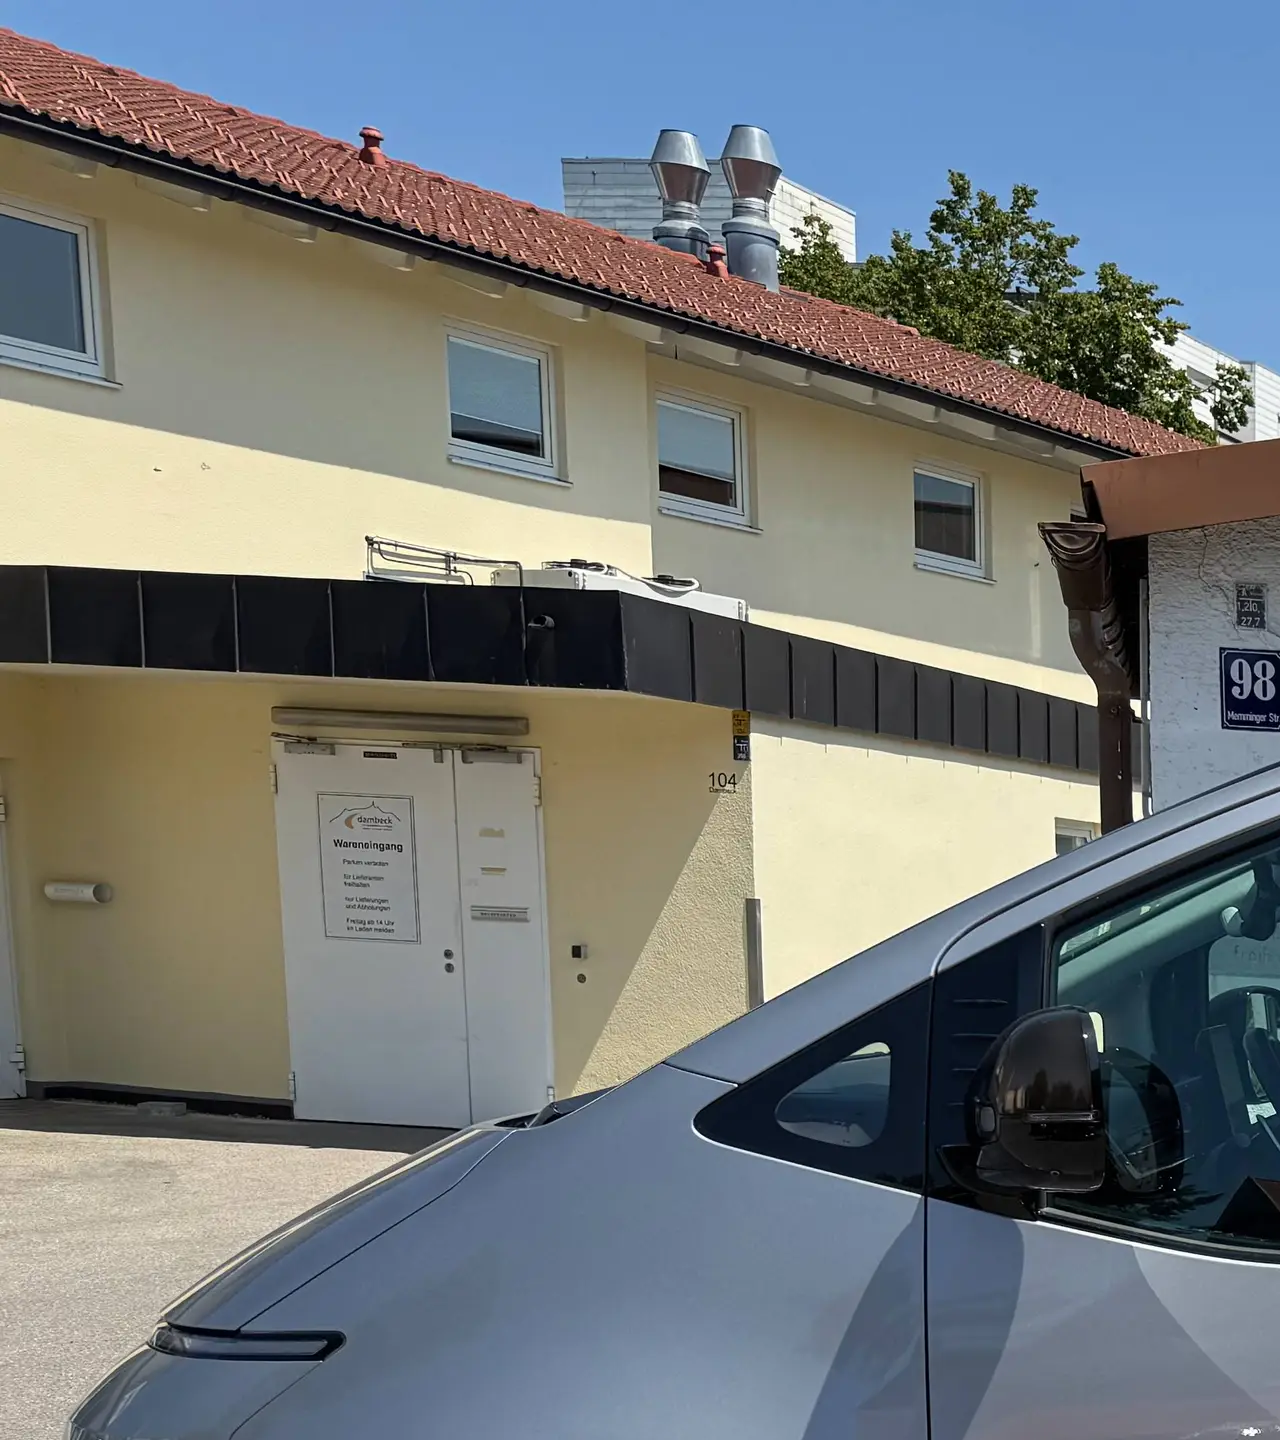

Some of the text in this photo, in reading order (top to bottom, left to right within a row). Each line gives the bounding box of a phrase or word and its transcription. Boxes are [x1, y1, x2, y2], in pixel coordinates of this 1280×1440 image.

[1229, 658, 1276, 701] 98
[1227, 710, 1267, 724] Memminger
[708, 772, 738, 789] 104
[333, 838, 403, 853] Wareneingang
